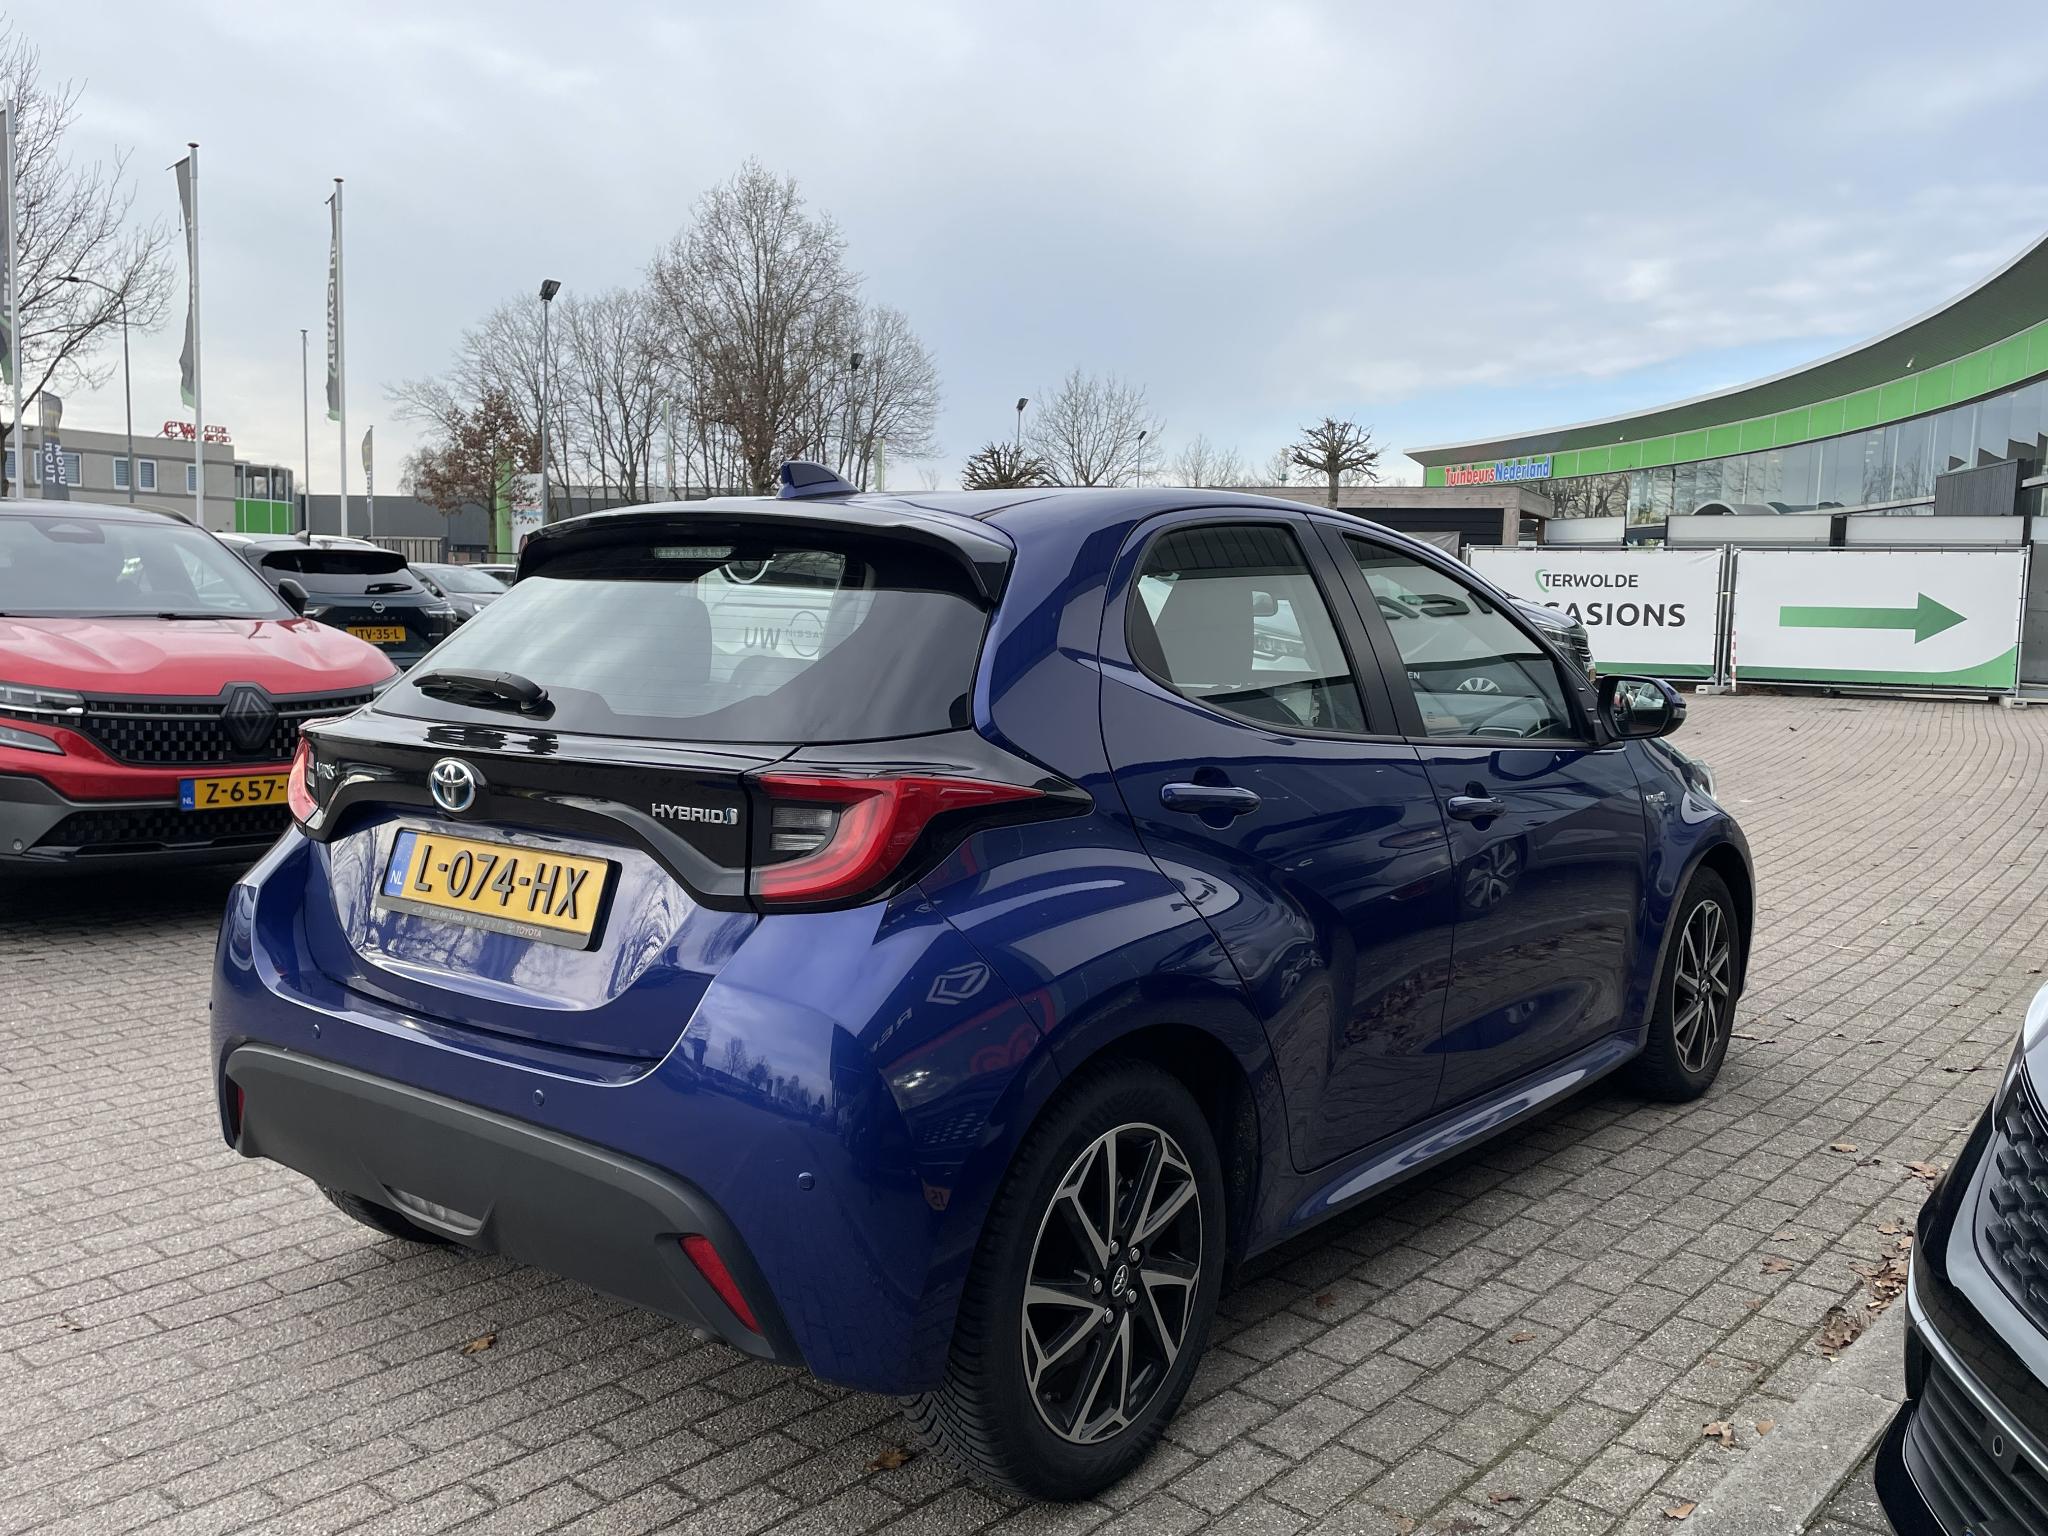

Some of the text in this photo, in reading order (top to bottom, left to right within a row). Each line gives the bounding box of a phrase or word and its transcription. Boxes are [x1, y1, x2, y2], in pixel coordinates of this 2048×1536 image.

[54, 444, 66, 485] MODU
[1543, 573, 1639, 588] TERWOLDE
[1532, 602, 1686, 627] ASIONS
[744, 626, 781, 650] UW
[182, 797, 193, 805] NL
[206, 778, 289, 804] Z-657-
[651, 803, 724, 824] HYBRID
[390, 870, 403, 885] NL
[414, 844, 589, 920] L-074-HX
[515, 926, 543, 939] TOYOTA
